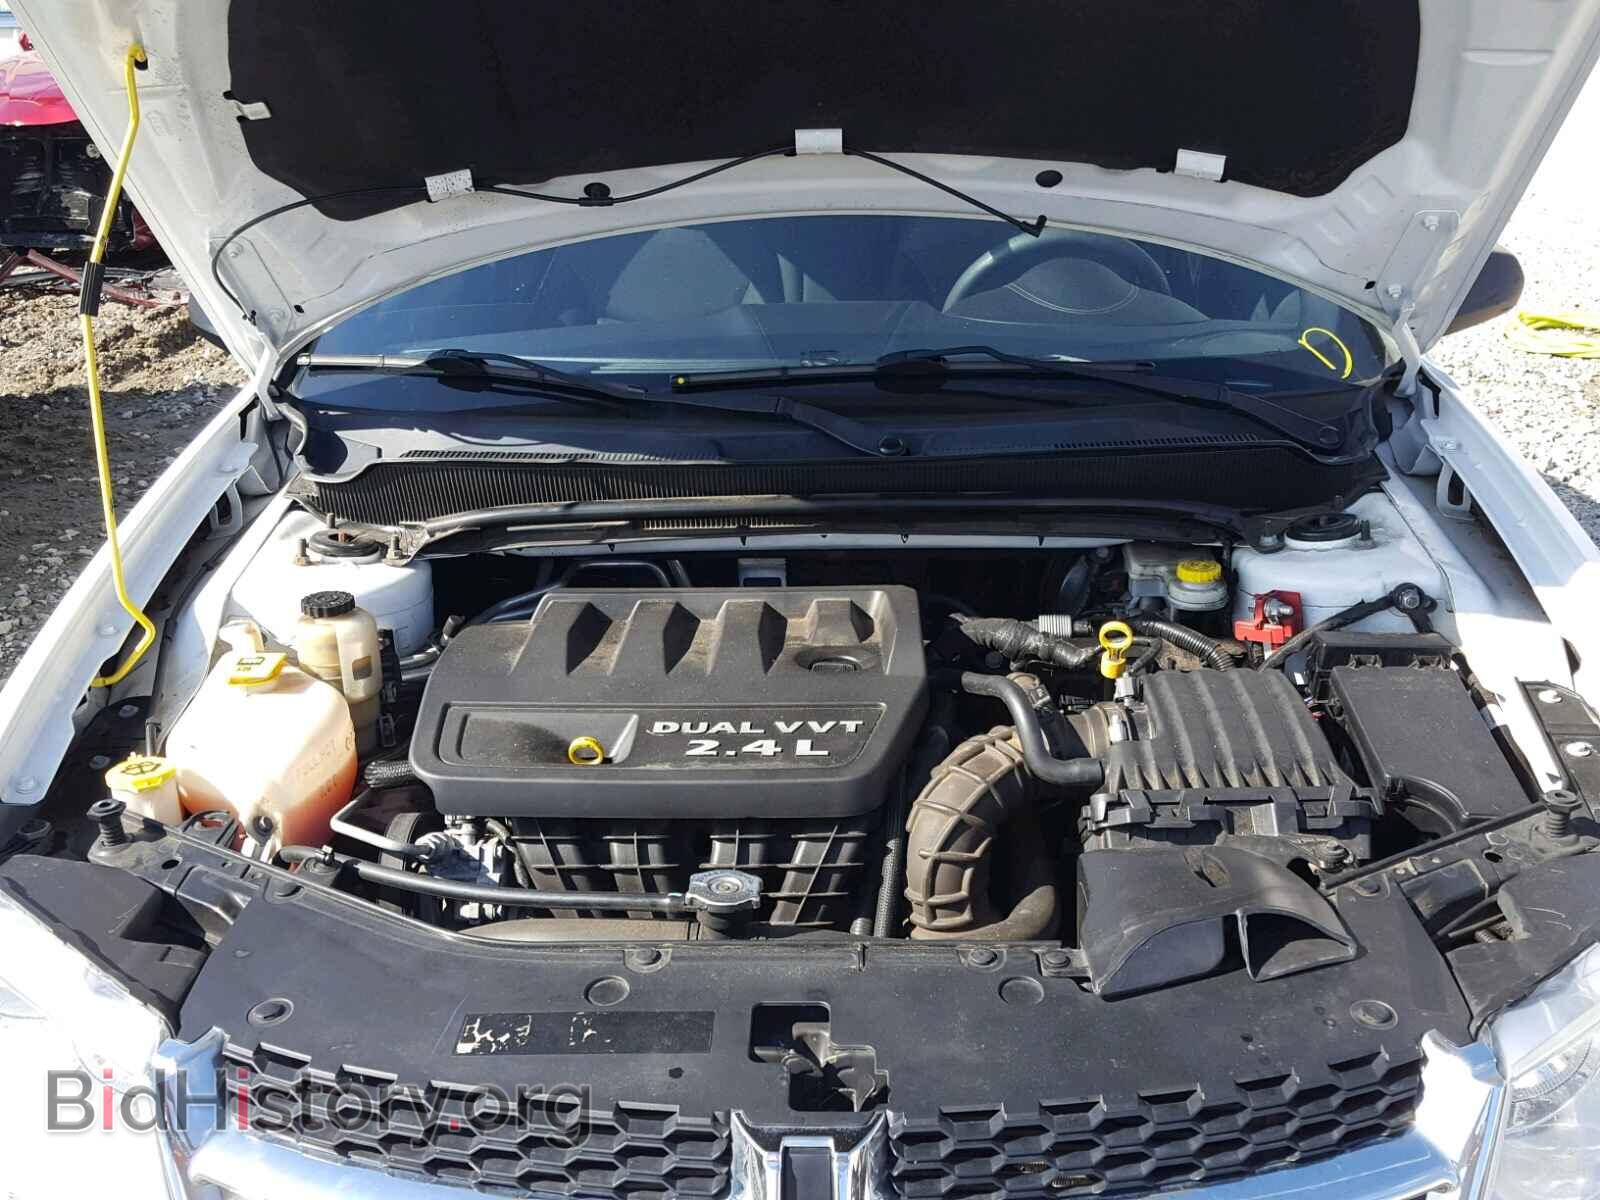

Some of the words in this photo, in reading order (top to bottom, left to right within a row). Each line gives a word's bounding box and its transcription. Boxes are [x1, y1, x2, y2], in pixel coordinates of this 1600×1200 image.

[652, 721, 765, 735] DUAL
[774, 720, 864, 735] VVT
[685, 739, 783, 757] 2.4
